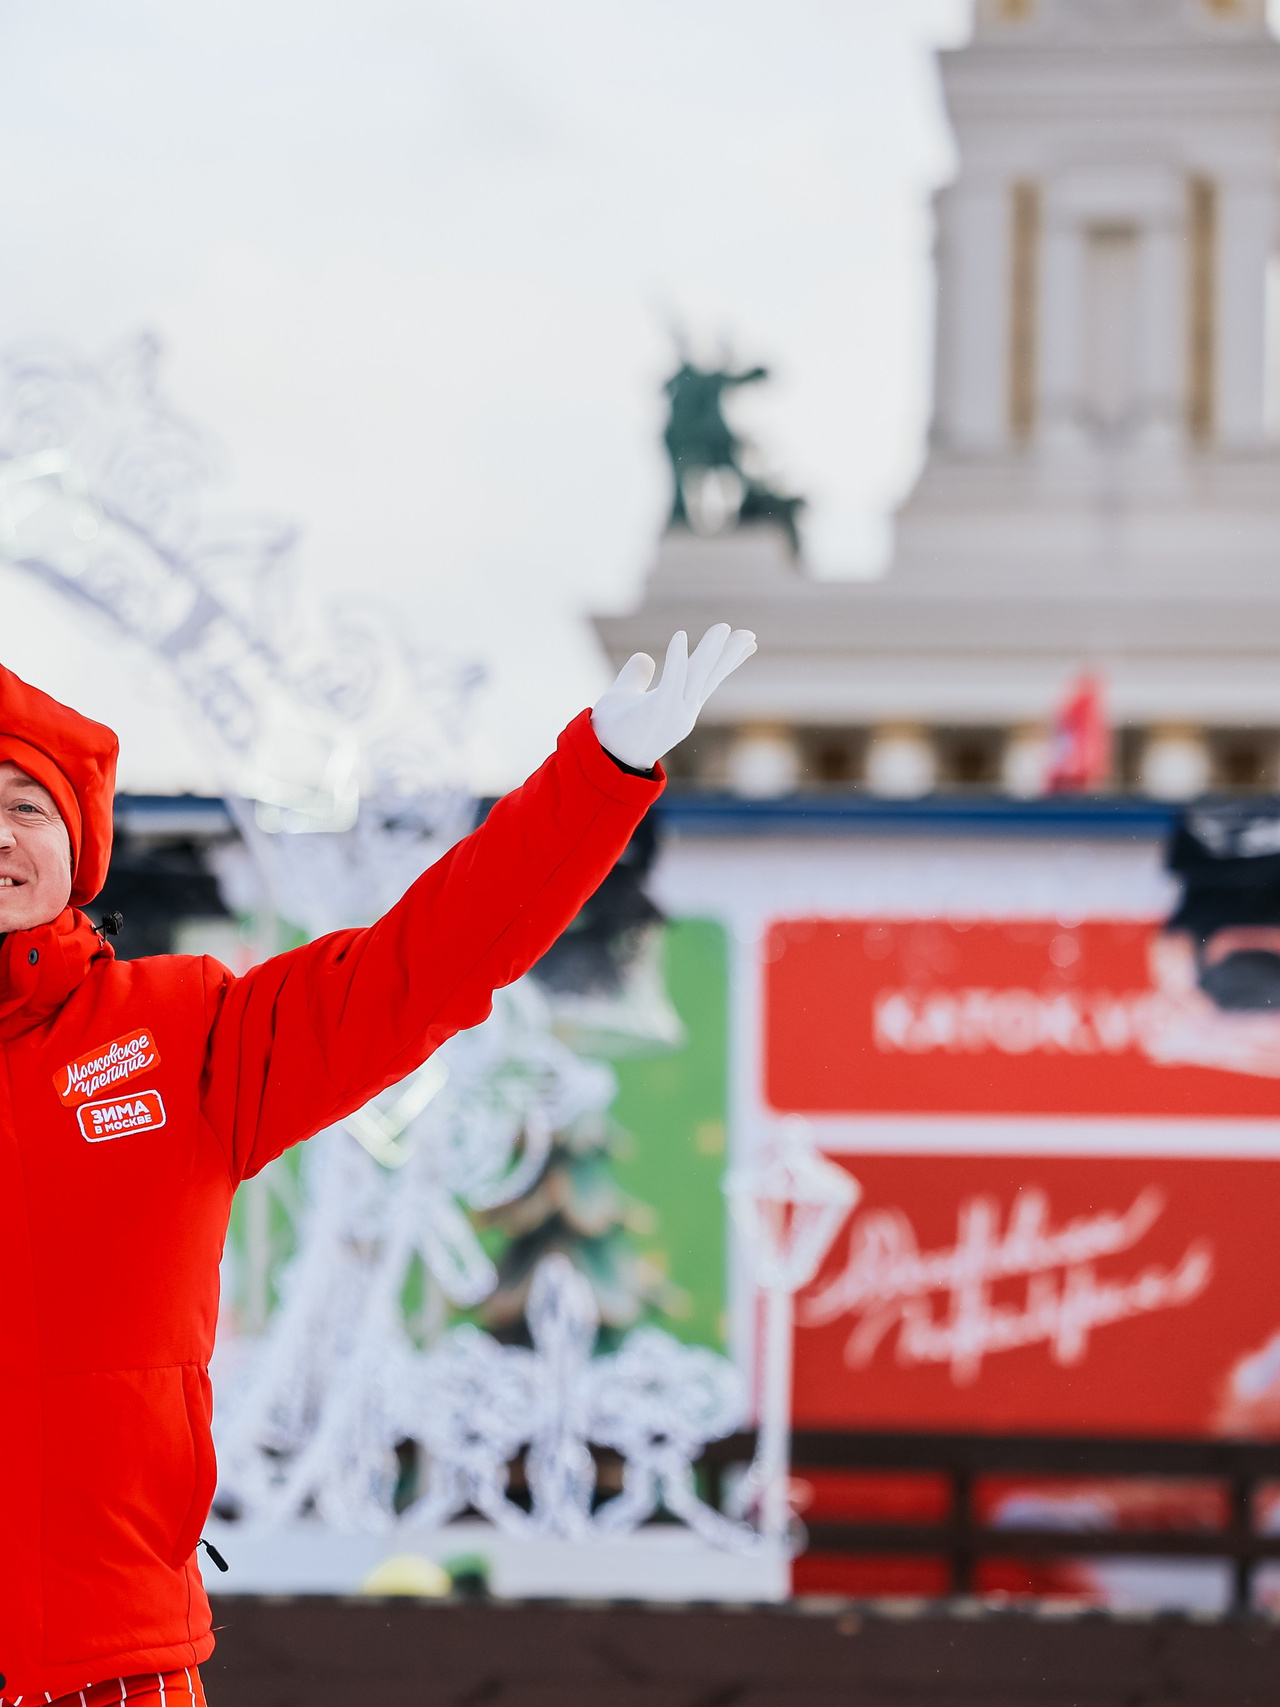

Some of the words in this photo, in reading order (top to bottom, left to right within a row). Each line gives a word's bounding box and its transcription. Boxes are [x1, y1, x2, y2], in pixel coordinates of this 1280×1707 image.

[62, 1035, 150, 1097] Московское
[90, 1100, 150, 1124] ЗИМА
[94, 1125, 103, 1135] В
[105, 1114, 153, 1133] МОСКВЕ
